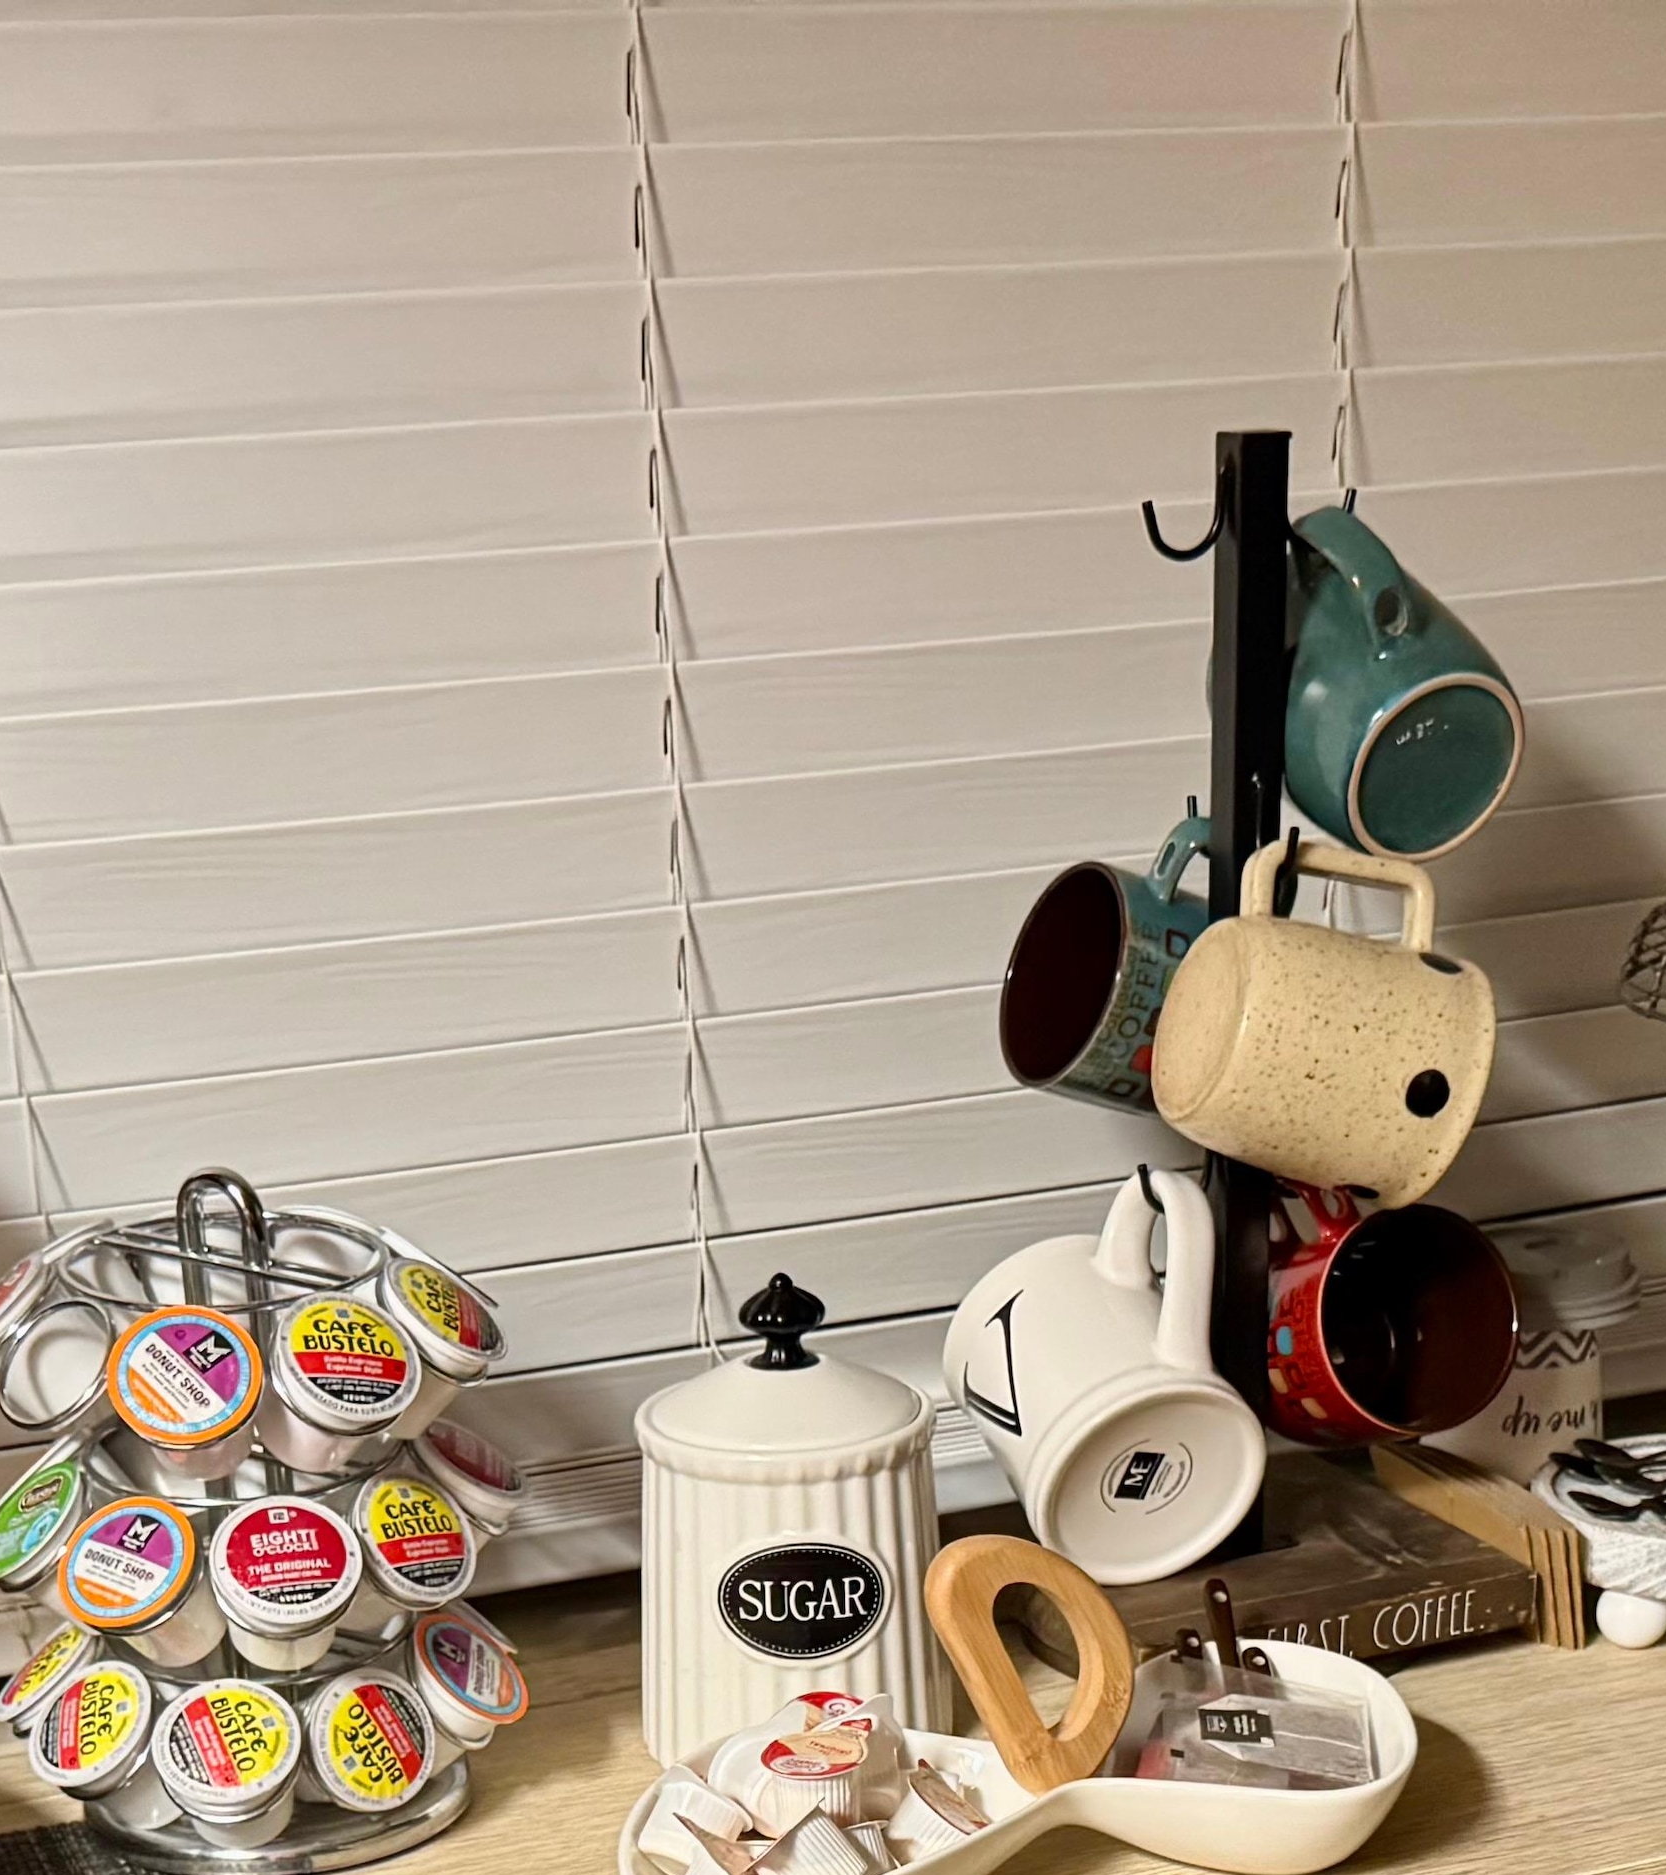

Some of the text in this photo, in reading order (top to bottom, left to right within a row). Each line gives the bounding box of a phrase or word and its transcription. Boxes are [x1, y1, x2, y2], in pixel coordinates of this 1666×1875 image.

[302, 1334, 395, 1358] BUSTELO
[145, 1343, 181, 1380] DONUT
[180, 1376, 211, 1408] SHOP
[1501, 1394, 1541, 1437] up
[249, 1529, 311, 1549] EIGHT
[380, 1514, 453, 1540] BUSTELO
[84, 1547, 123, 1570] DONUT
[122, 1562, 155, 1583] SHOP
[247, 1562, 273, 1577] THE
[273, 1557, 332, 1572] ORIGINAL
[252, 1542, 314, 1558] O'CLOCK
[738, 1576, 868, 1622] SUGAR
[1373, 1589, 1485, 1650] COFFEE.
[79, 1680, 101, 1756] BUSTELO
[210, 1696, 256, 1772] BUSTELO
[348, 1702, 405, 1785] BUSTELO
